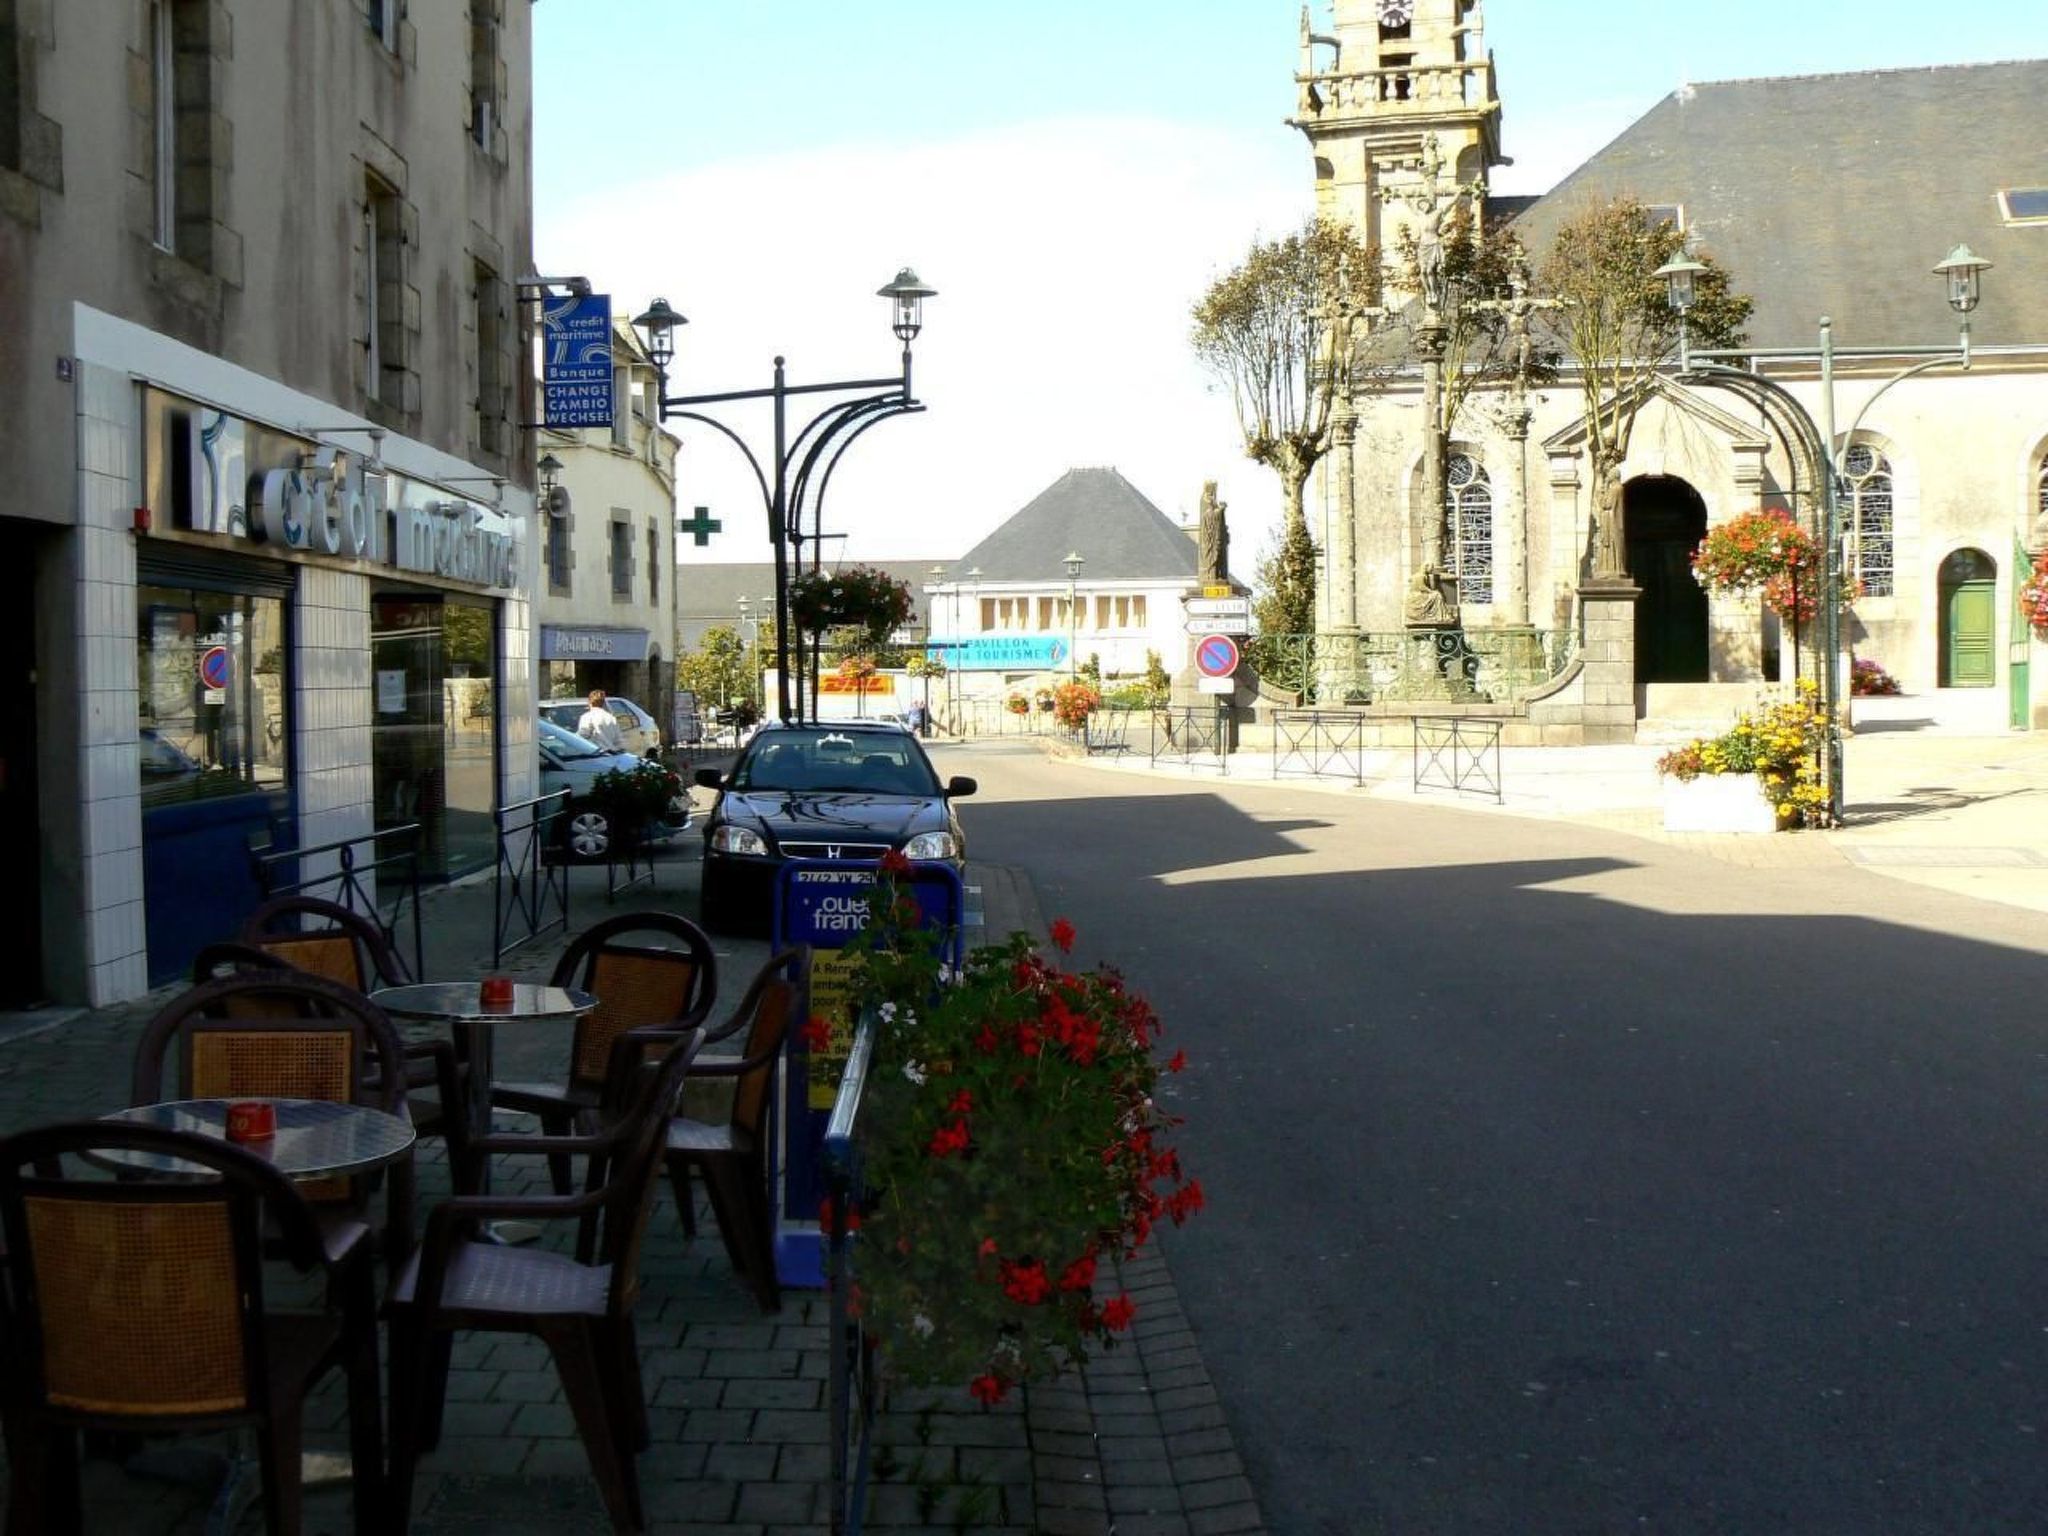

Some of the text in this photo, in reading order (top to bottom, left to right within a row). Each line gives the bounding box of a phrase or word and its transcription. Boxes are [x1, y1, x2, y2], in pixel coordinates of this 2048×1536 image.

[549, 330, 605, 341] maritime
[550, 367, 605, 380] Banque
[548, 385, 609, 398] CHANGE
[549, 398, 607, 411] CAMBIO
[546, 411, 612, 424] WECHSEL
[976, 649, 1043, 661] TOURISME
